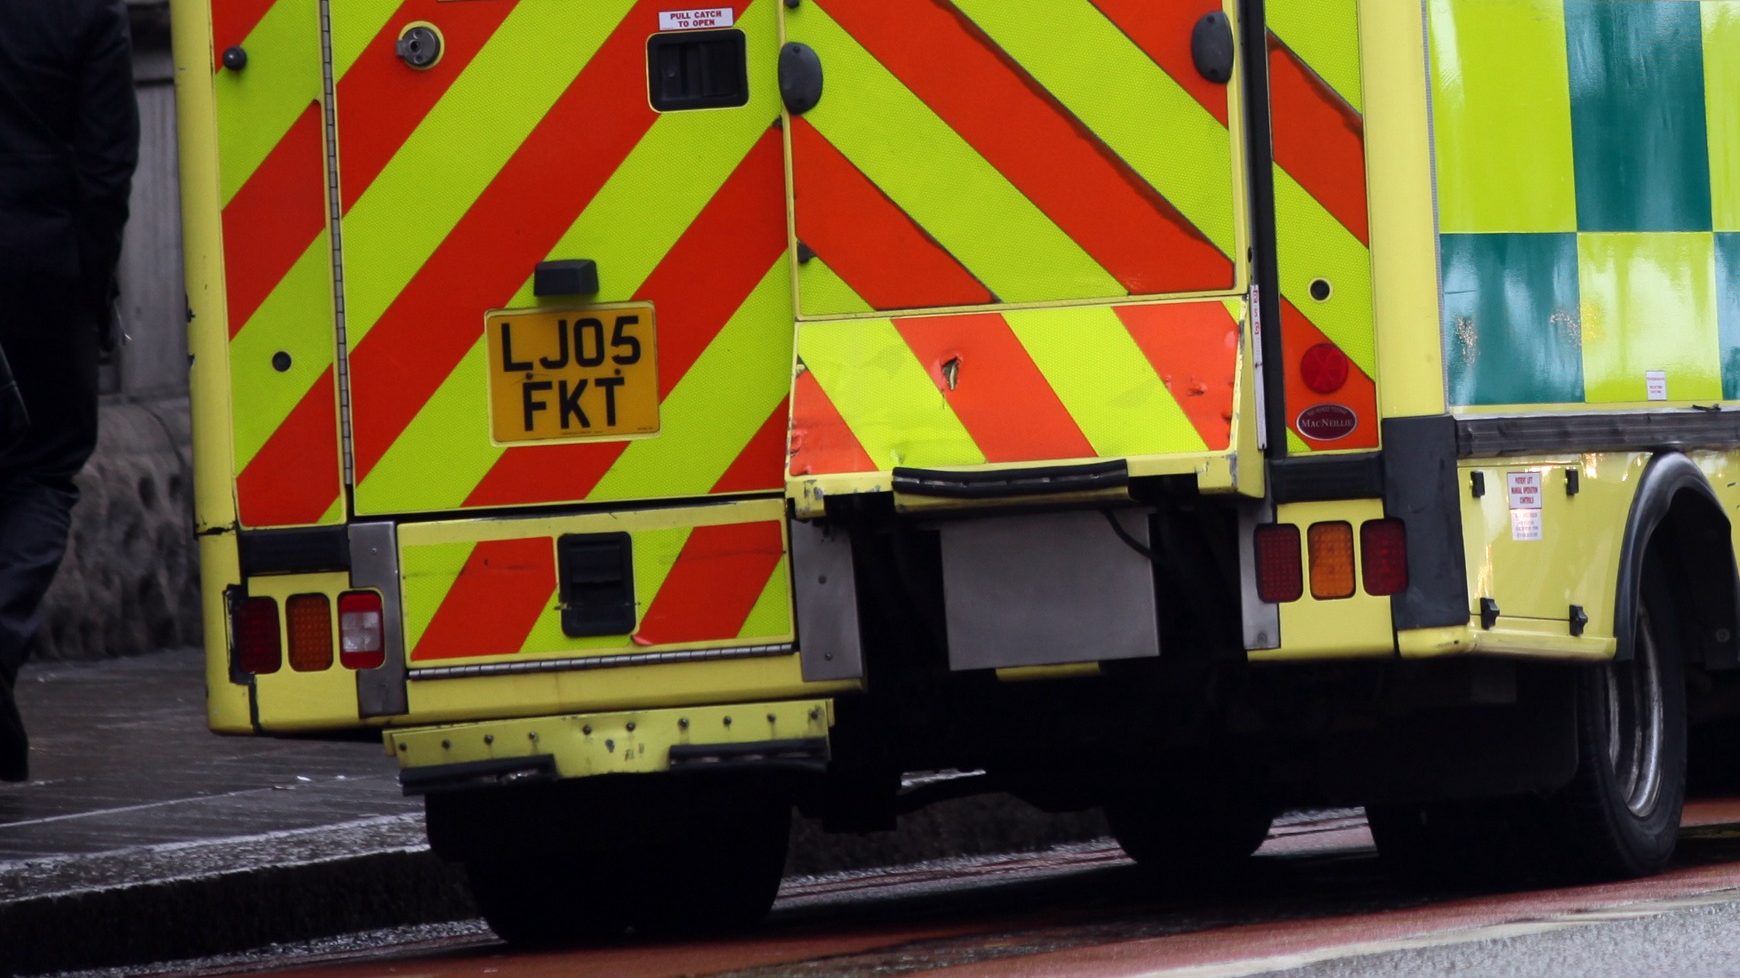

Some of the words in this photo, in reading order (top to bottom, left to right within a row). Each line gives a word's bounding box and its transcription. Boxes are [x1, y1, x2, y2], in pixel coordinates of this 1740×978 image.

[670, 12, 691, 20] PULL
[694, 10, 722, 19] CATCH
[678, 20, 689, 28] TO
[692, 19, 715, 27] OPEN
[501, 315, 642, 373] LJ05
[522, 376, 625, 432] FKT
